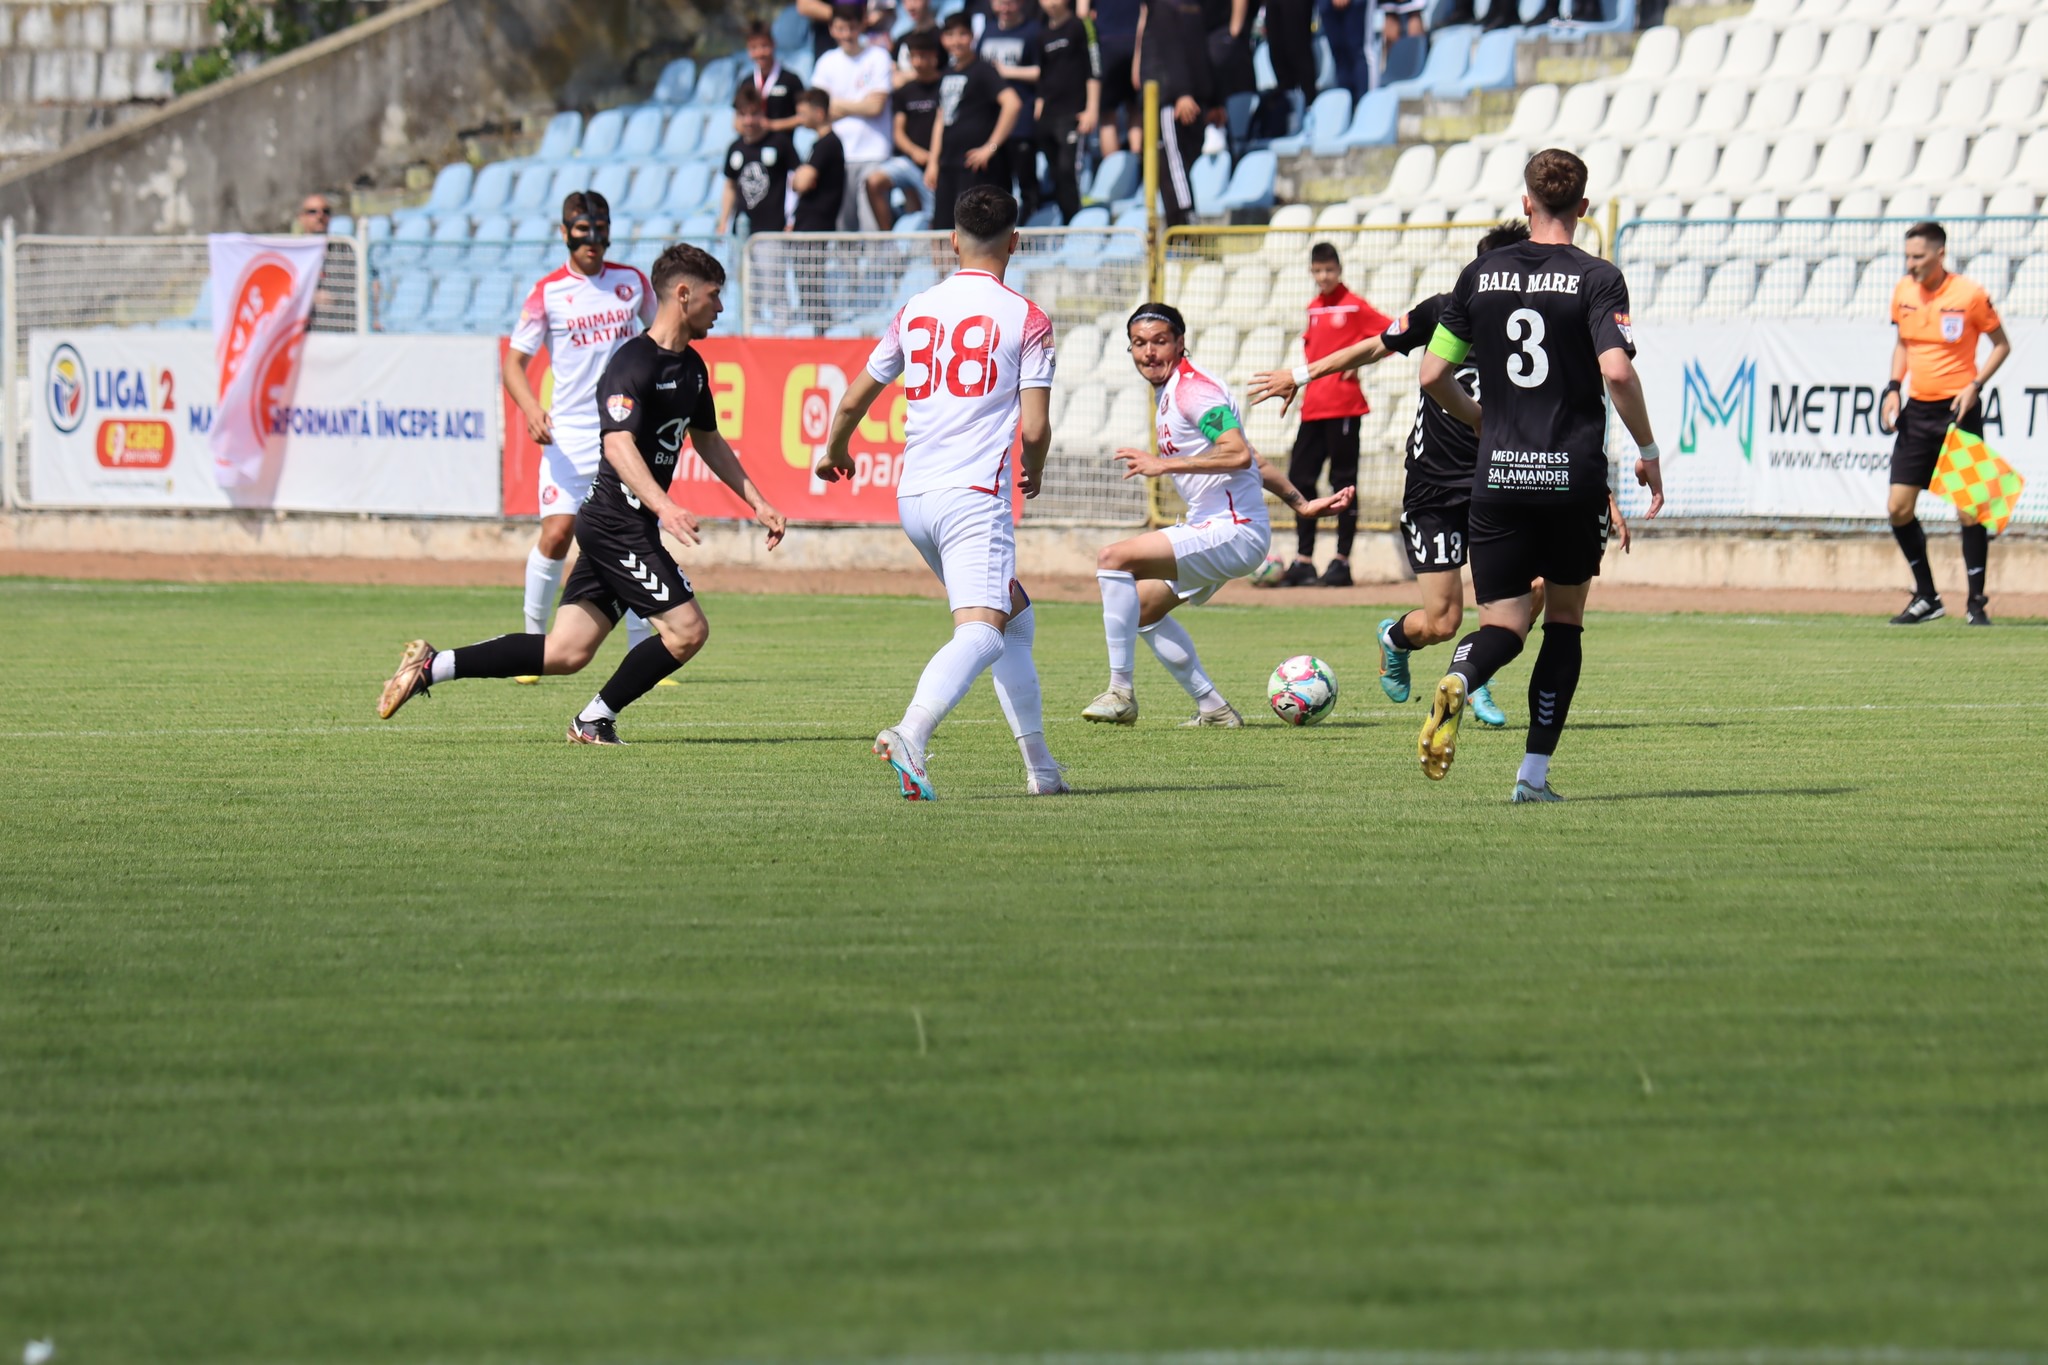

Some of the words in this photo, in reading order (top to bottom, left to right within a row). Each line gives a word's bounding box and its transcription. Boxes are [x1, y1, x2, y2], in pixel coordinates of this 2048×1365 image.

[1478, 271, 1521, 293] BAIA
[1526, 272, 1580, 295] MARE
[905, 315, 1001, 400] 38
[1506, 308, 1549, 388] 3
[94, 369, 148, 410] LIGA
[160, 369, 175, 411] 2
[1491, 450, 1569, 464] MEDIAPRESS
[1769, 449, 1891, 475] www.metropo
[1488, 468, 1569, 482] SALAMANDER
[1433, 531, 1463, 565] 13
